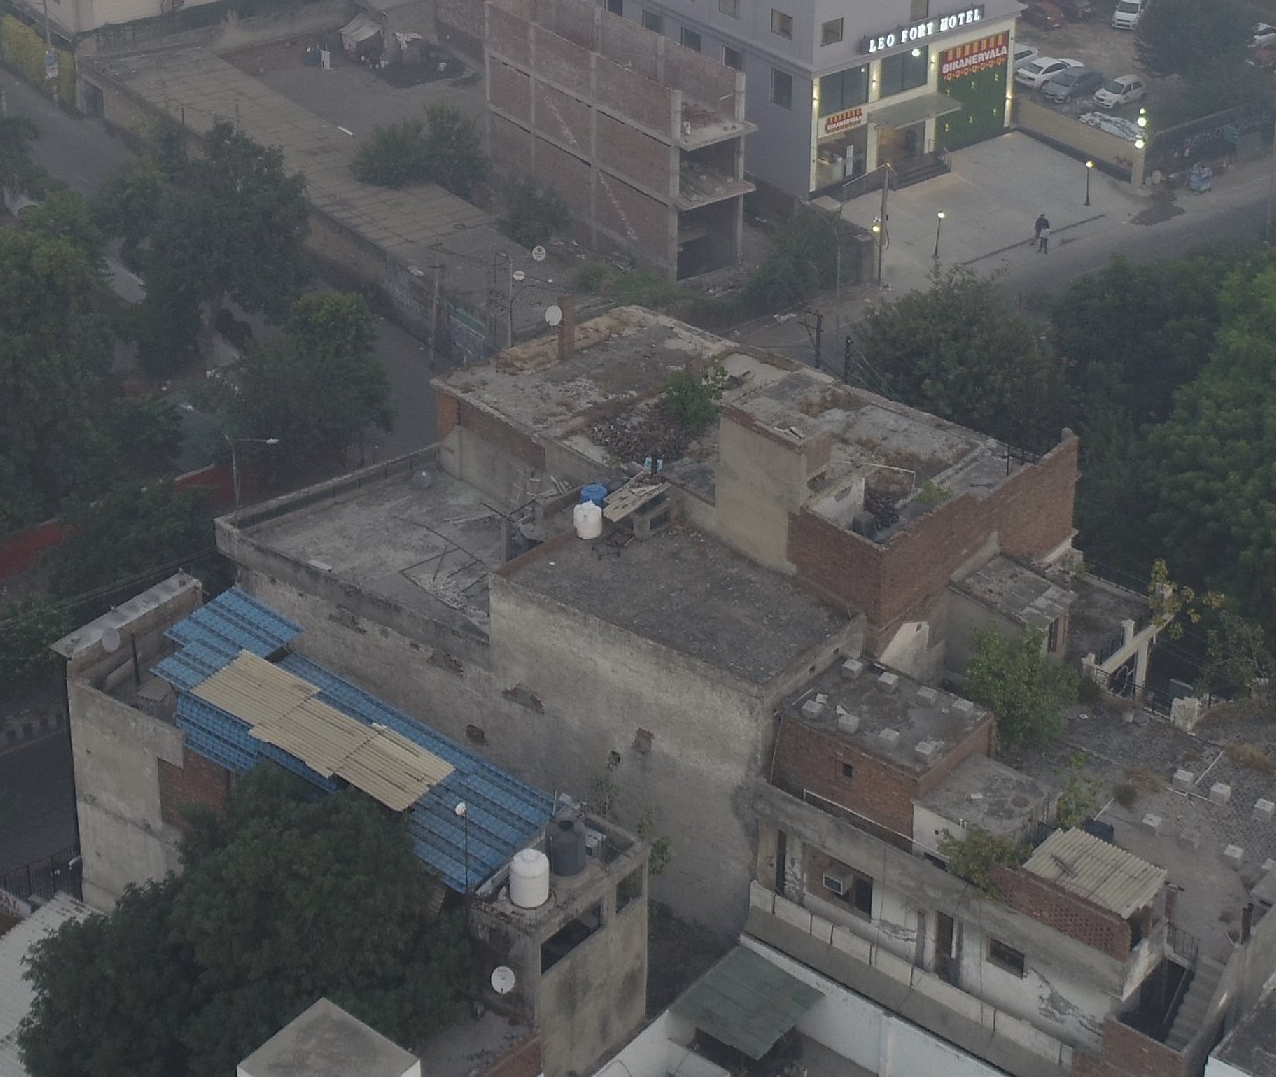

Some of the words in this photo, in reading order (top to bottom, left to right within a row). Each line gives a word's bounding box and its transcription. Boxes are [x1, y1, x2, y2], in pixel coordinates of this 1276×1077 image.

[868, 34, 895, 53] LEO
[901, 22, 933, 43] FORT
[939, 8, 980, 32] HOTEL
[942, 45, 1008, 74] BIKANERVALA
